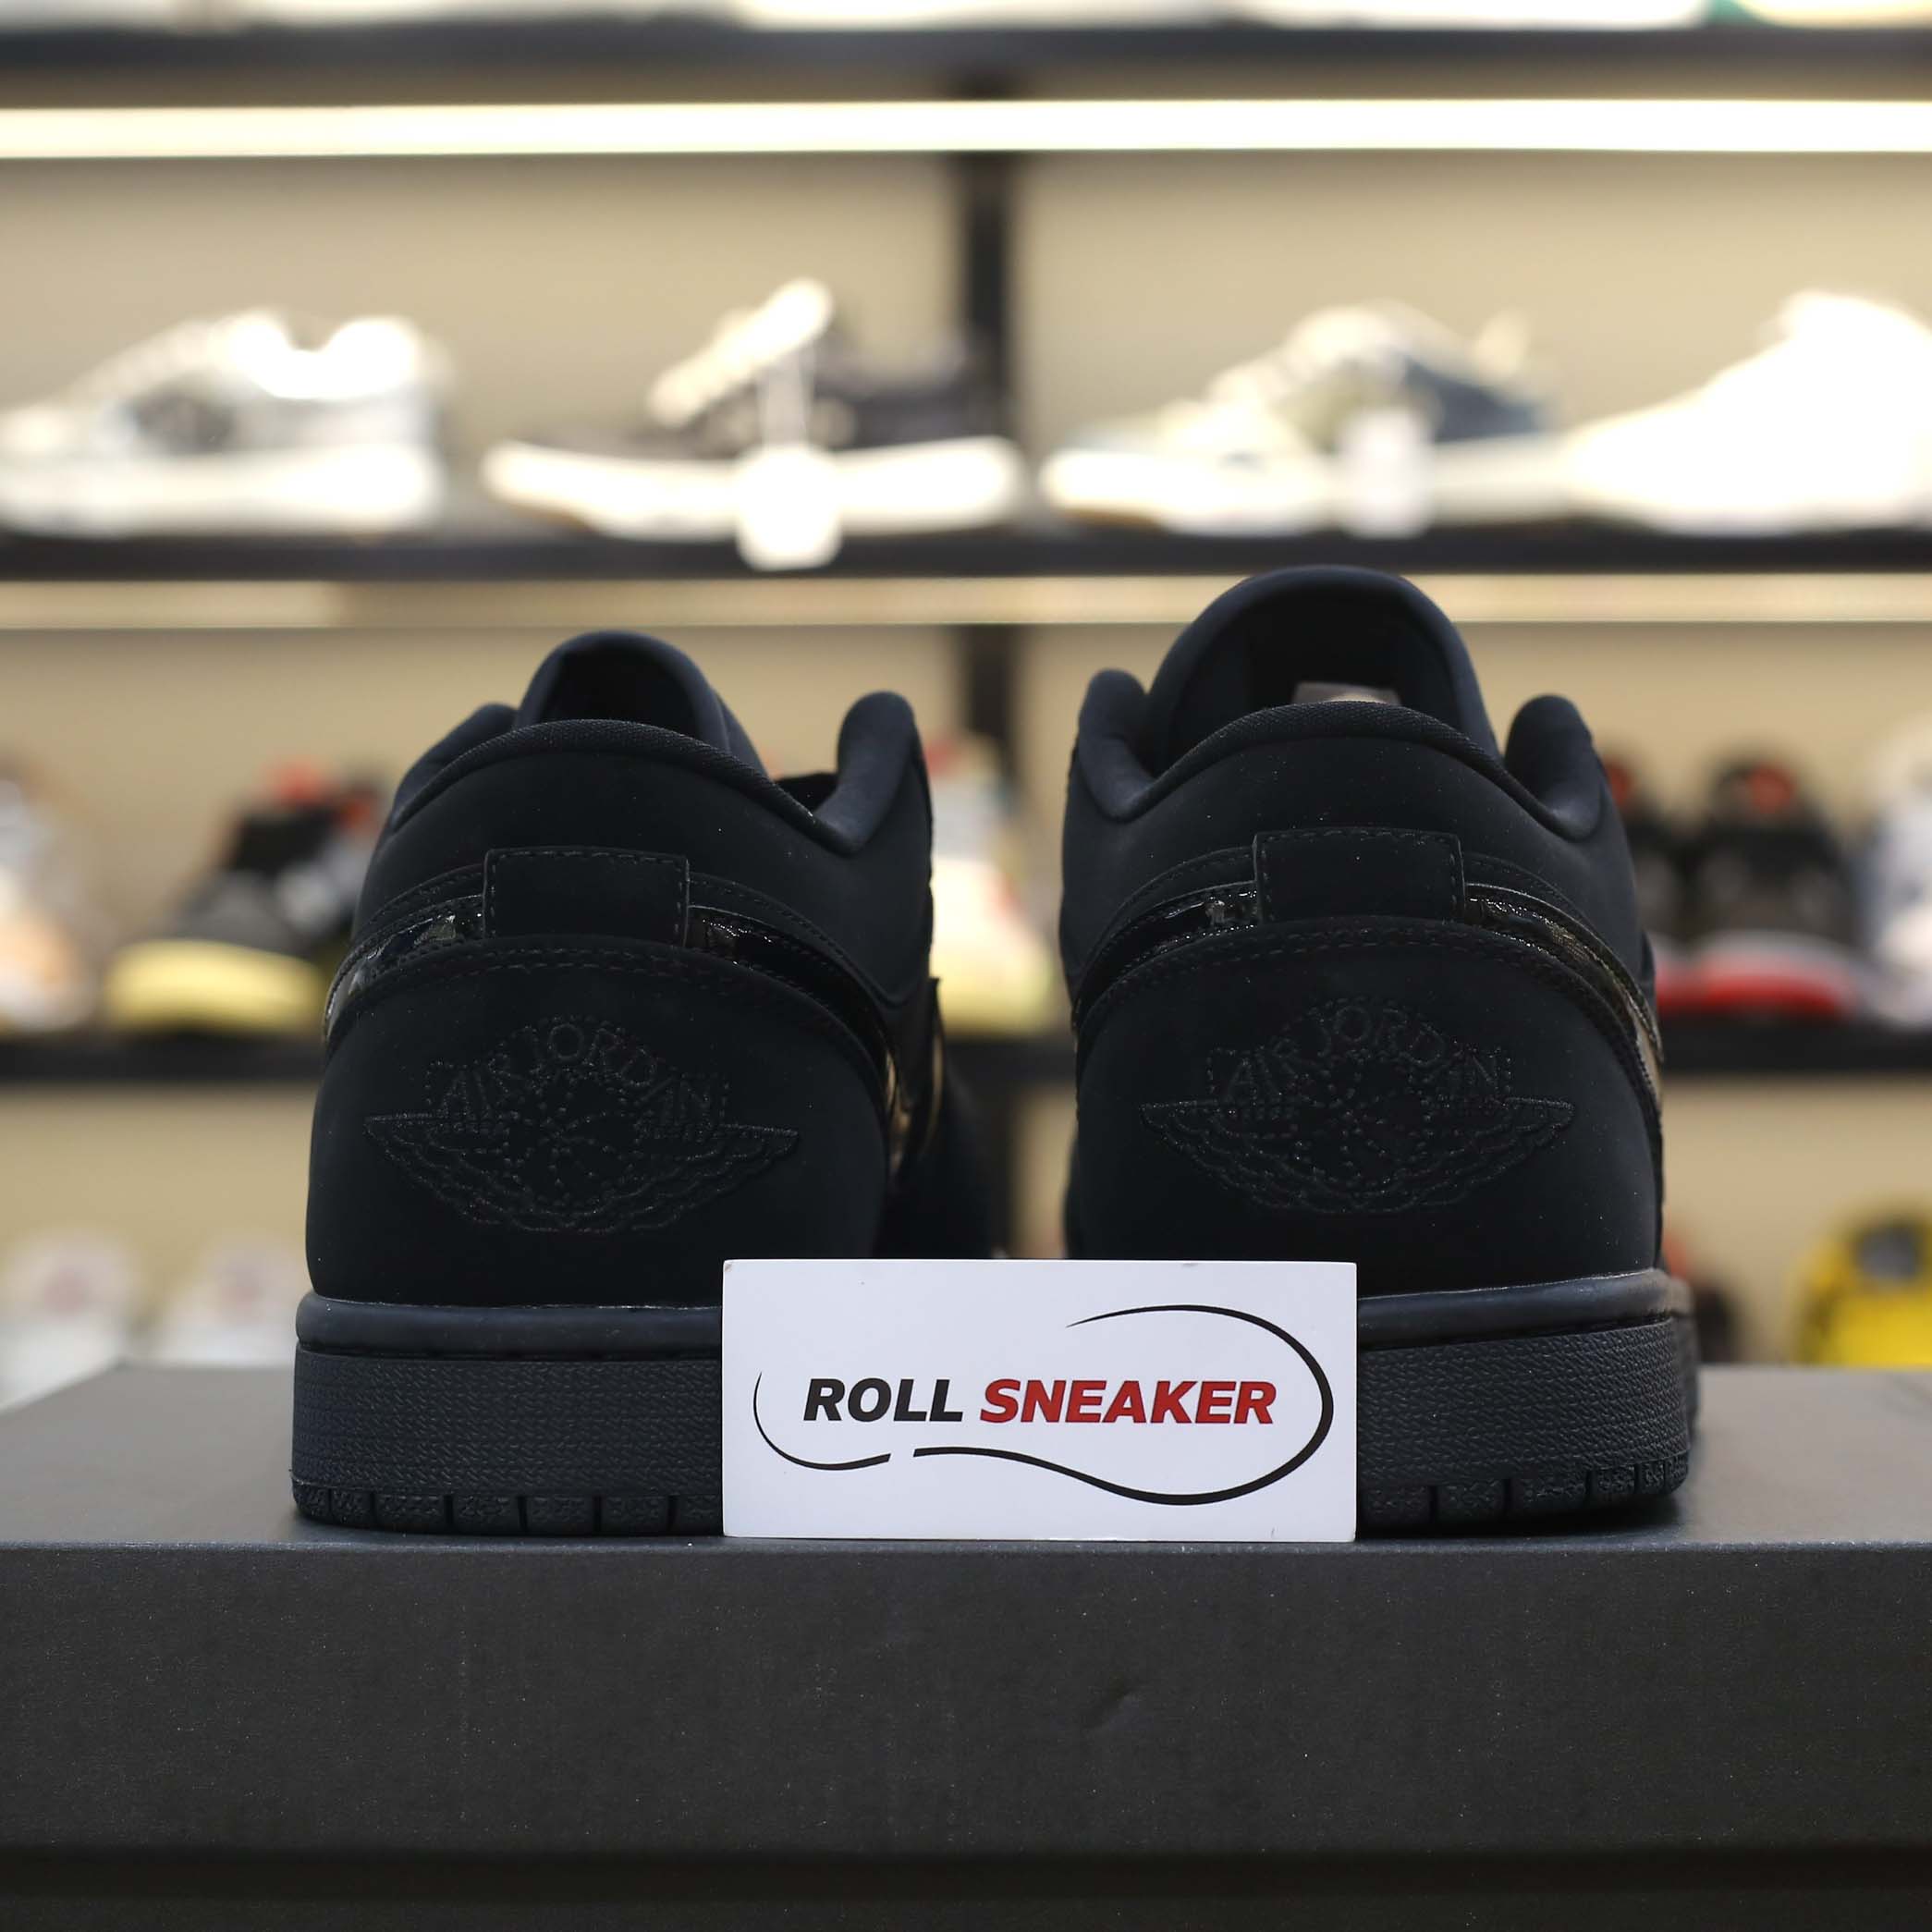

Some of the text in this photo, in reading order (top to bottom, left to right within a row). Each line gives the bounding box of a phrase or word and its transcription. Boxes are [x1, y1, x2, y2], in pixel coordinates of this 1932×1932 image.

[441, 1022, 719, 1141] AIR JORDAN
[1221, 1005, 1501, 1120] AIR JORDAN
[802, 1377, 1278, 1425] ROLL SNEAKER
